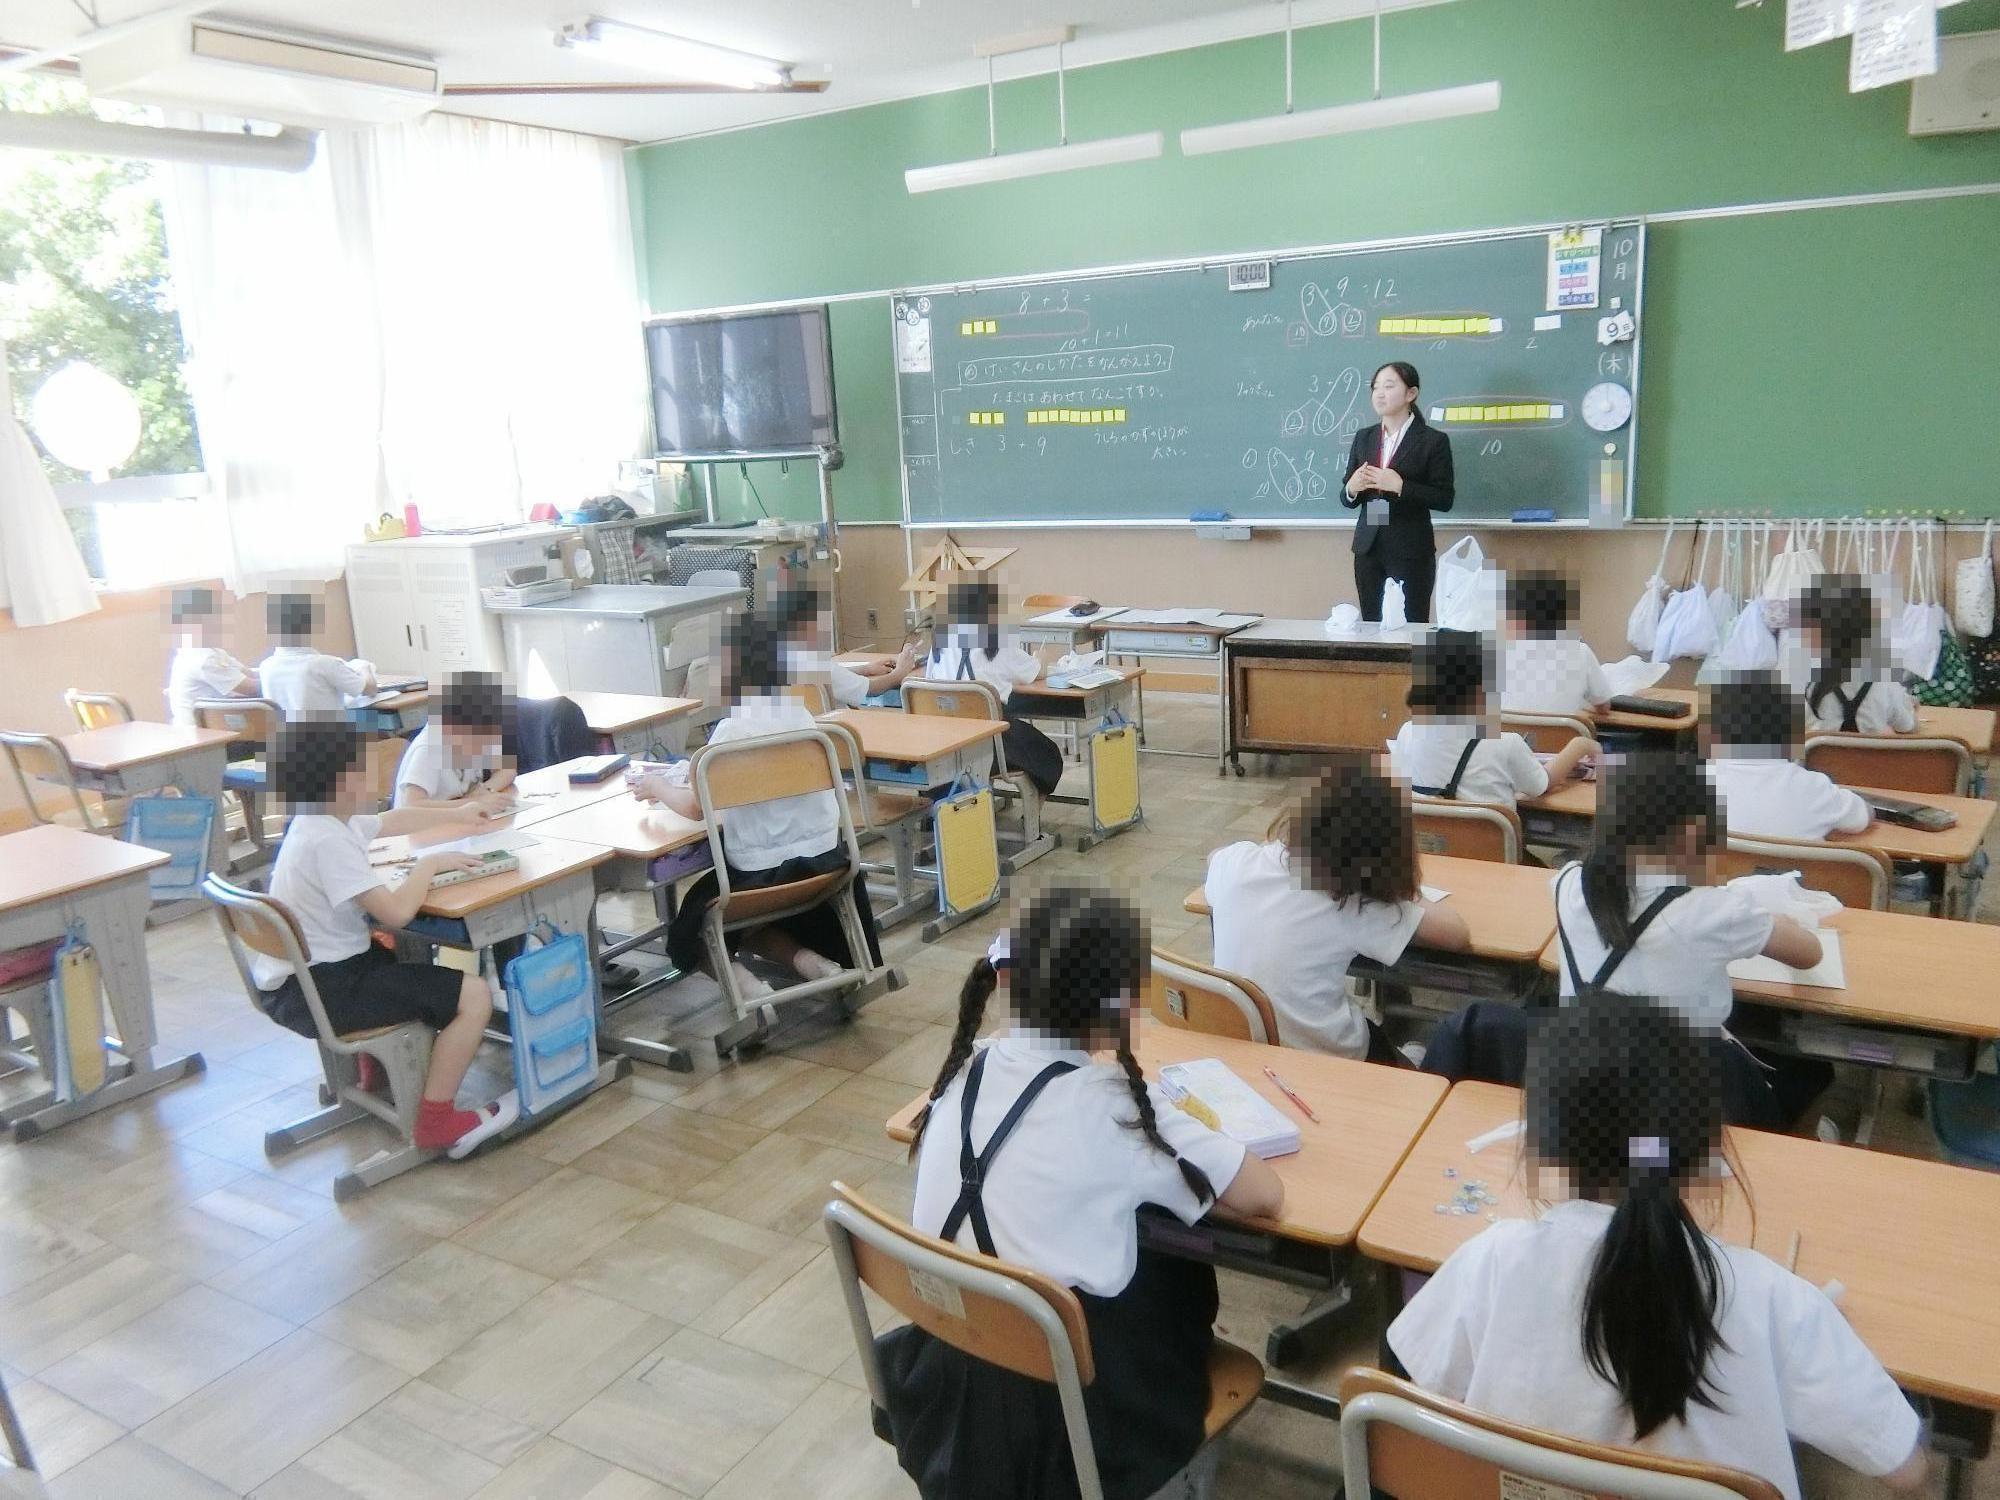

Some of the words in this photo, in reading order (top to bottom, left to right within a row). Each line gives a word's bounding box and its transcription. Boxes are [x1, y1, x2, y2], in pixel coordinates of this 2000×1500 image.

[1613, 262, 1627, 281] 月
[1337, 276, 1349, 297] 9
[1374, 275, 1397, 299] 12
[1019, 288, 1031, 314] 8
[1058, 288, 1070, 313] 3
[1309, 375, 1319, 393] 3
[1344, 372, 1353, 393] 9
[999, 434, 1006, 452] 3
[1037, 434, 1047, 456] 9
[1480, 440, 1501, 456] 10
